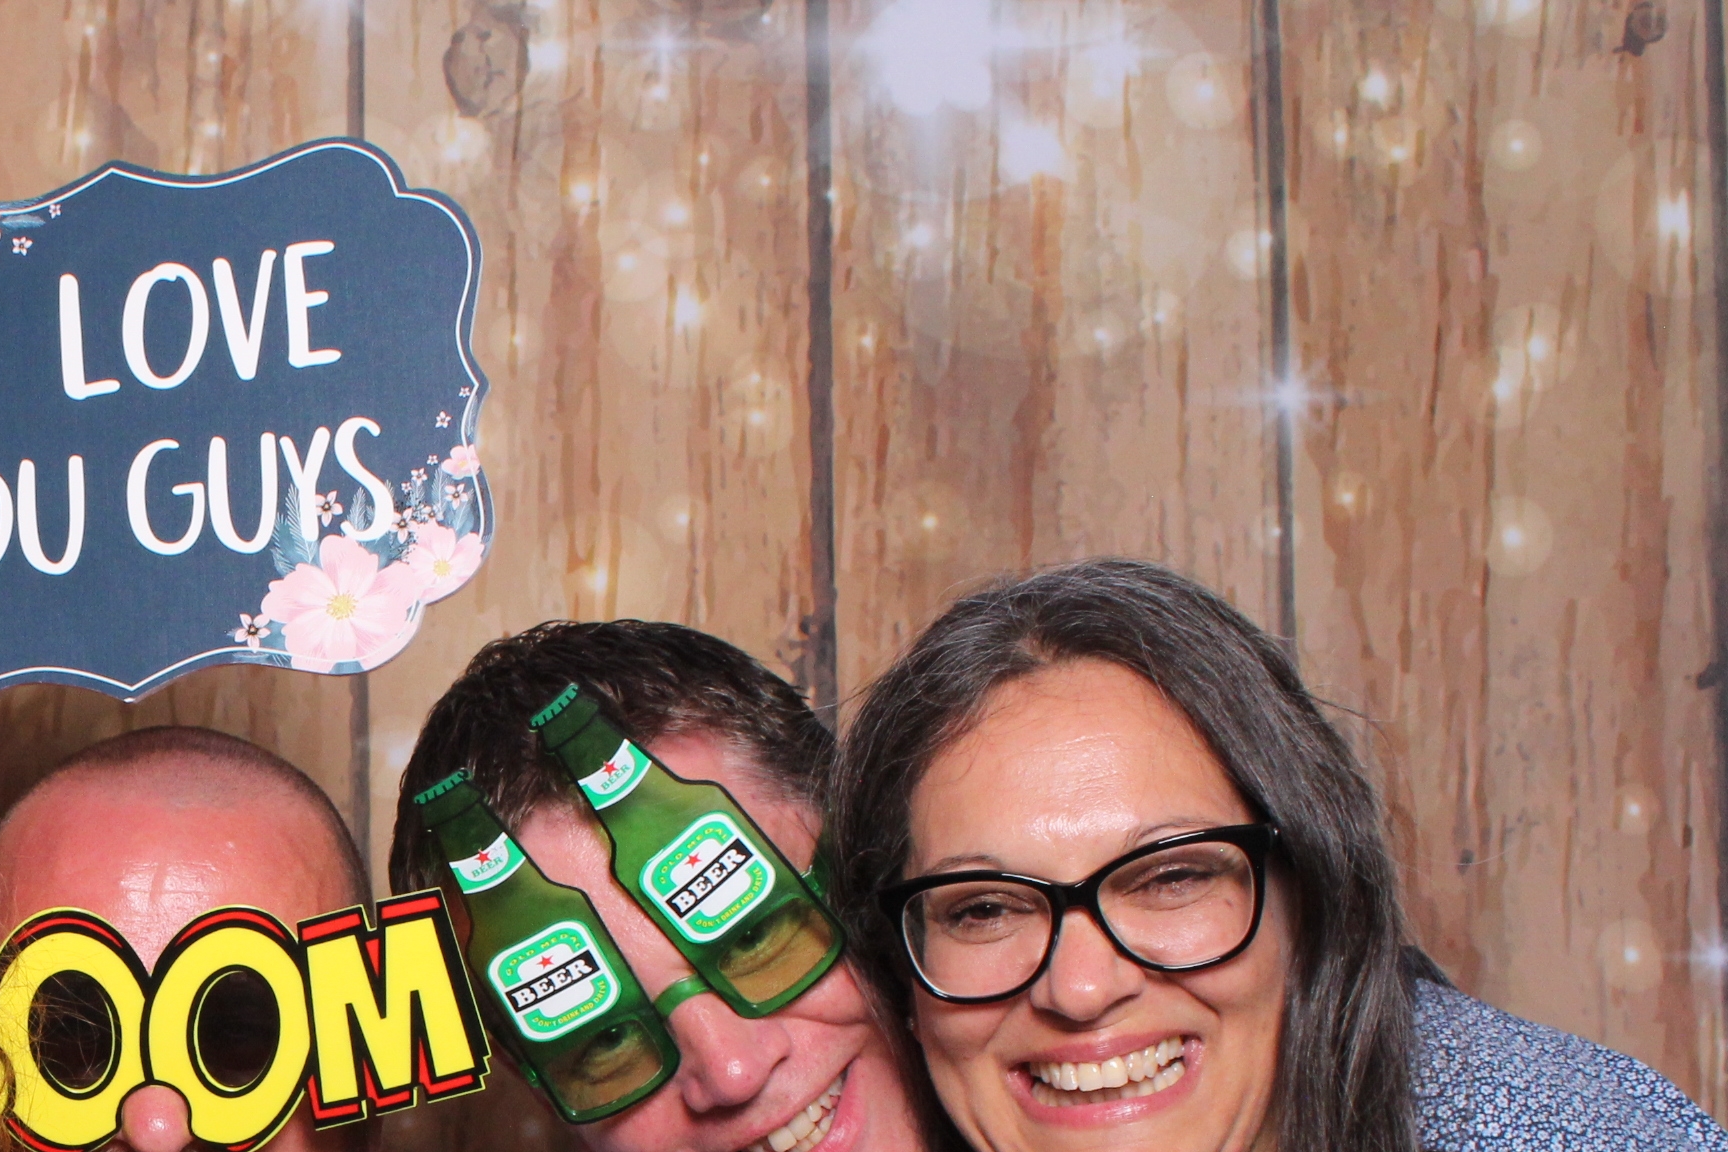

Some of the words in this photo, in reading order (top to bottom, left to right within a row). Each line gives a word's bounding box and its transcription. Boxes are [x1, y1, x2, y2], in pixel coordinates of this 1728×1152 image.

[60, 240, 341, 400] LOVE
[127, 417, 395, 555] GUYS
[601, 764, 631, 791] BEER
[471, 857, 504, 878] BEER
[672, 849, 747, 913] BEER
[511, 959, 592, 1007] BEER
